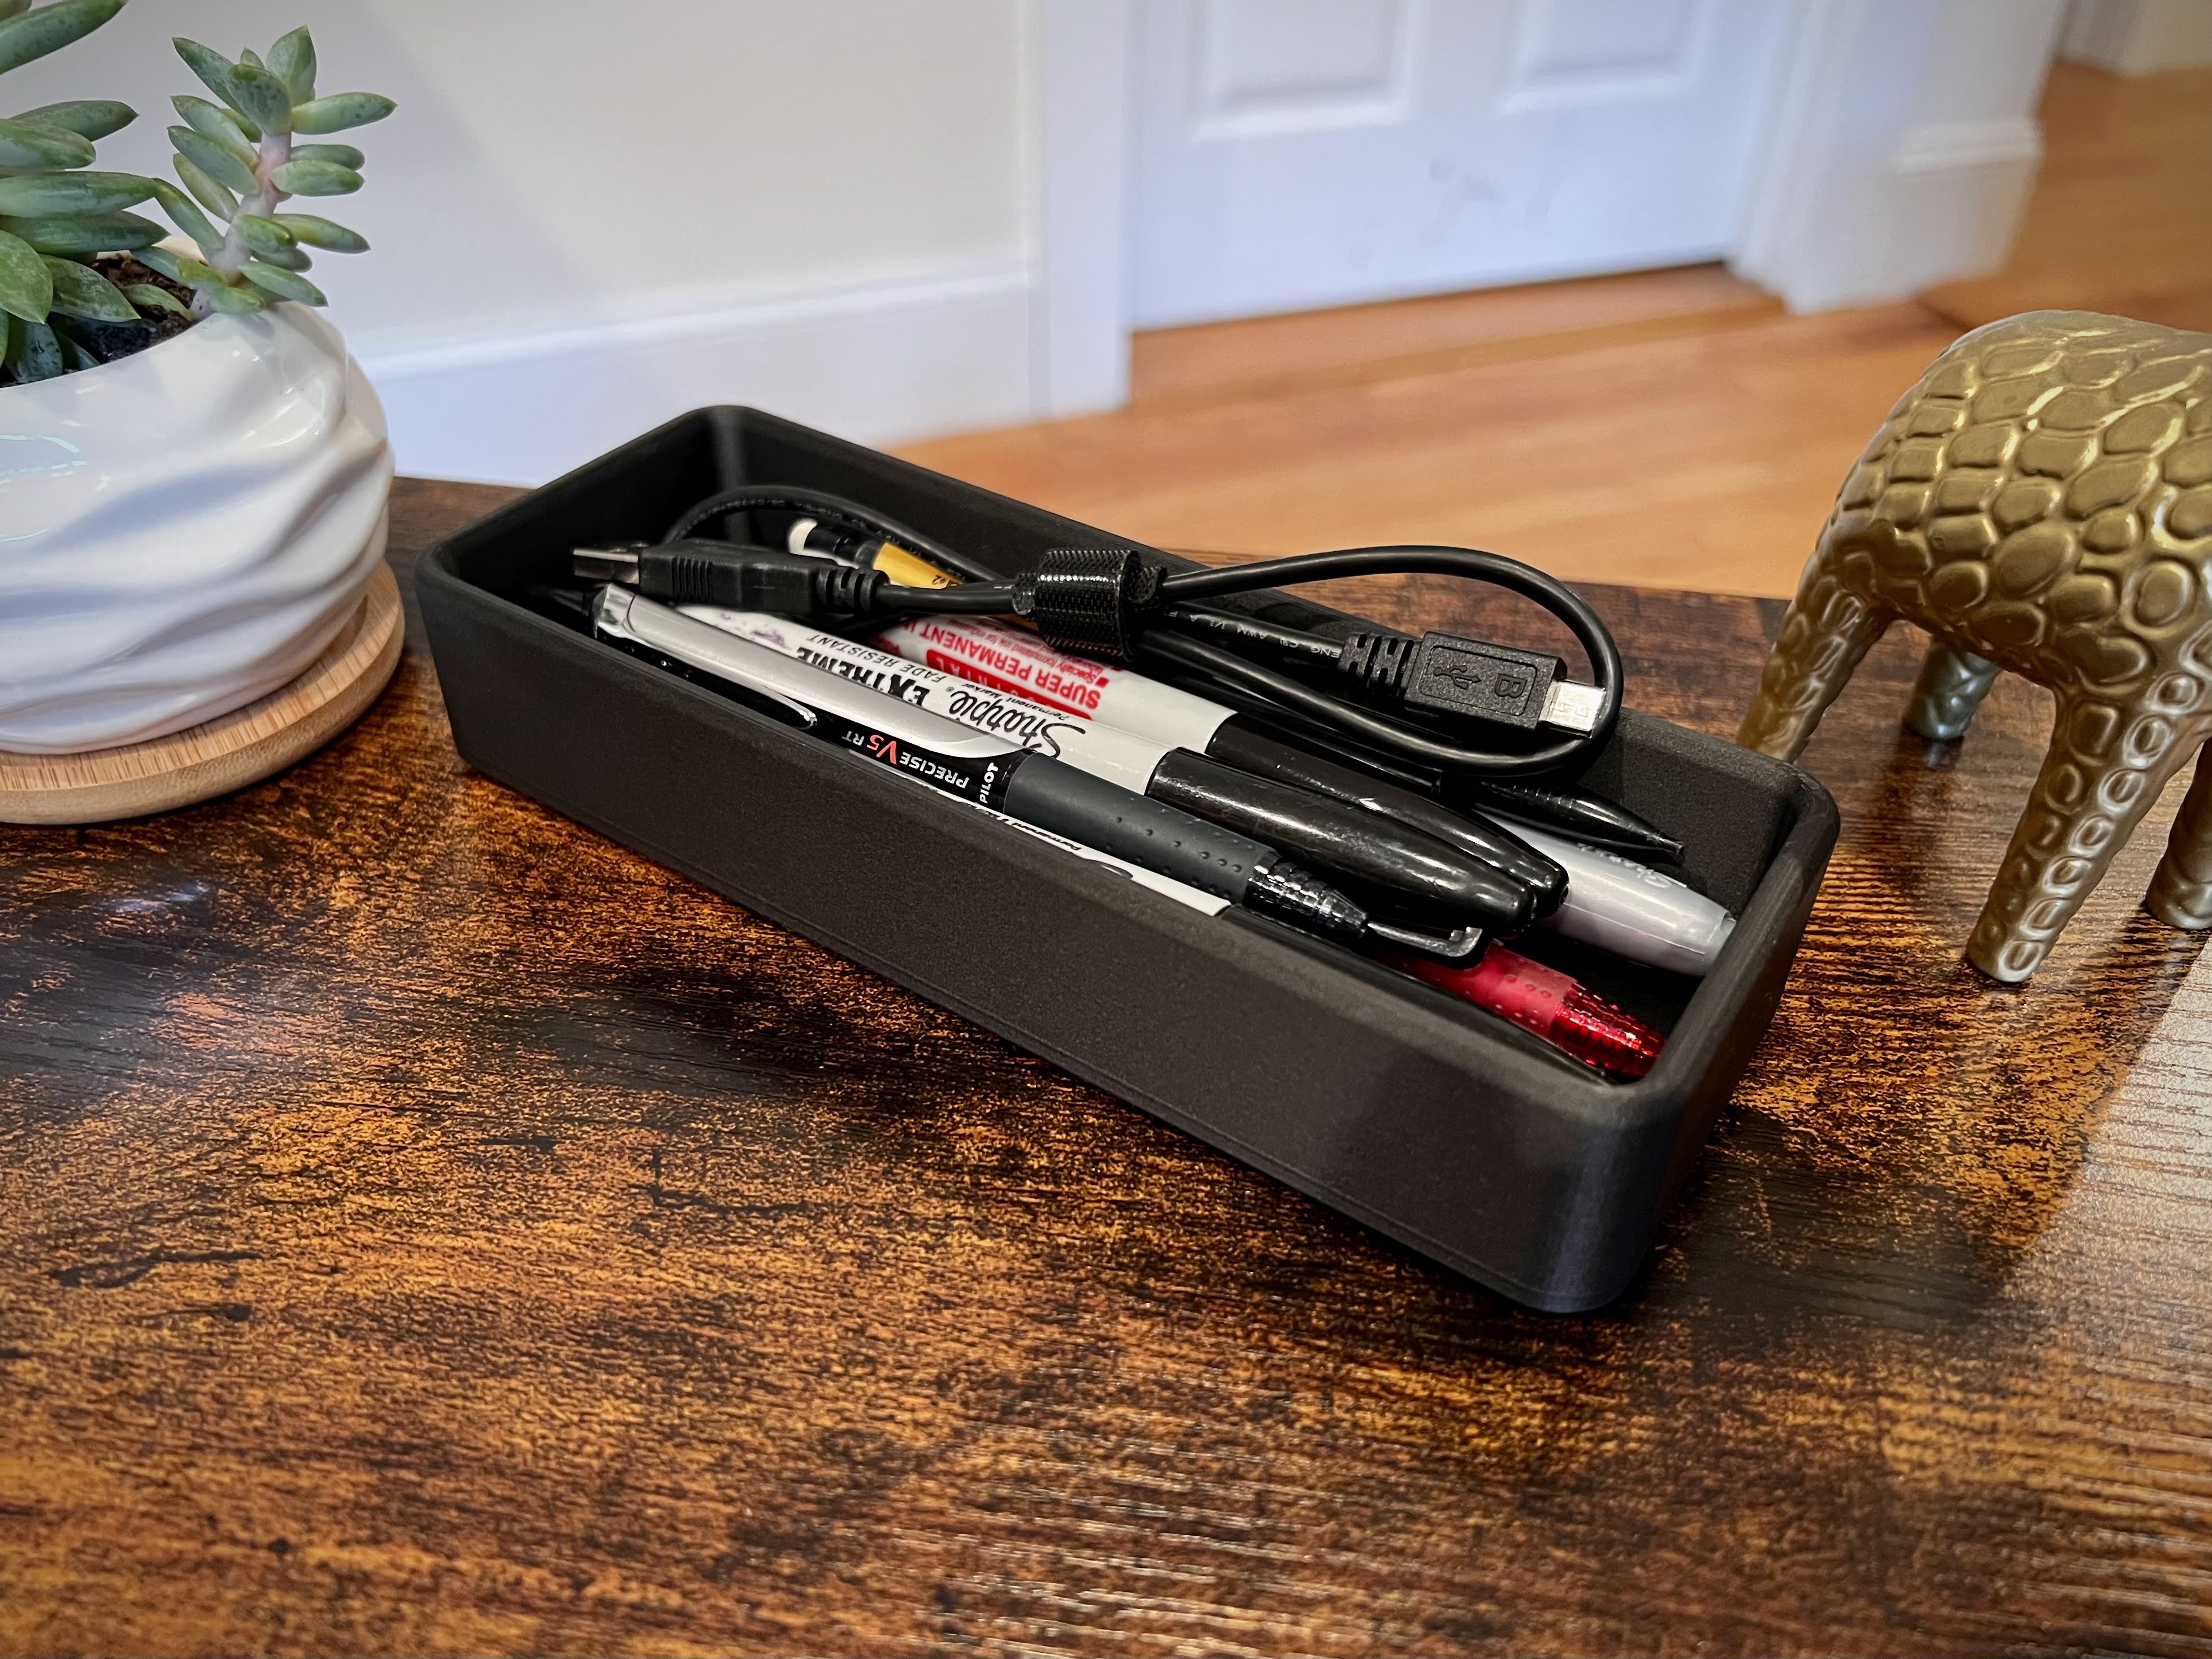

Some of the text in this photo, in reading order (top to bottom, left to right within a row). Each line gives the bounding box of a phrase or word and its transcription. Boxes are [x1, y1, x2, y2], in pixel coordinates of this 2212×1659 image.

[986, 631, 997, 640] for
[997, 638, 1009, 647] ink
[806, 634, 900, 668] RESISTANT
[919, 622, 1033, 681] PERMANENT
[1009, 643, 1057, 669] formulated
[900, 663, 947, 683] FADE
[1056, 659, 1099, 684] Specially
[1494, 673, 1528, 699] B
[961, 682, 1069, 721] Permanent Marker
[1035, 669, 1101, 710] SUPER
[840, 730, 970, 789] PRECISE V5 RT
[979, 762, 999, 804] PILOT
